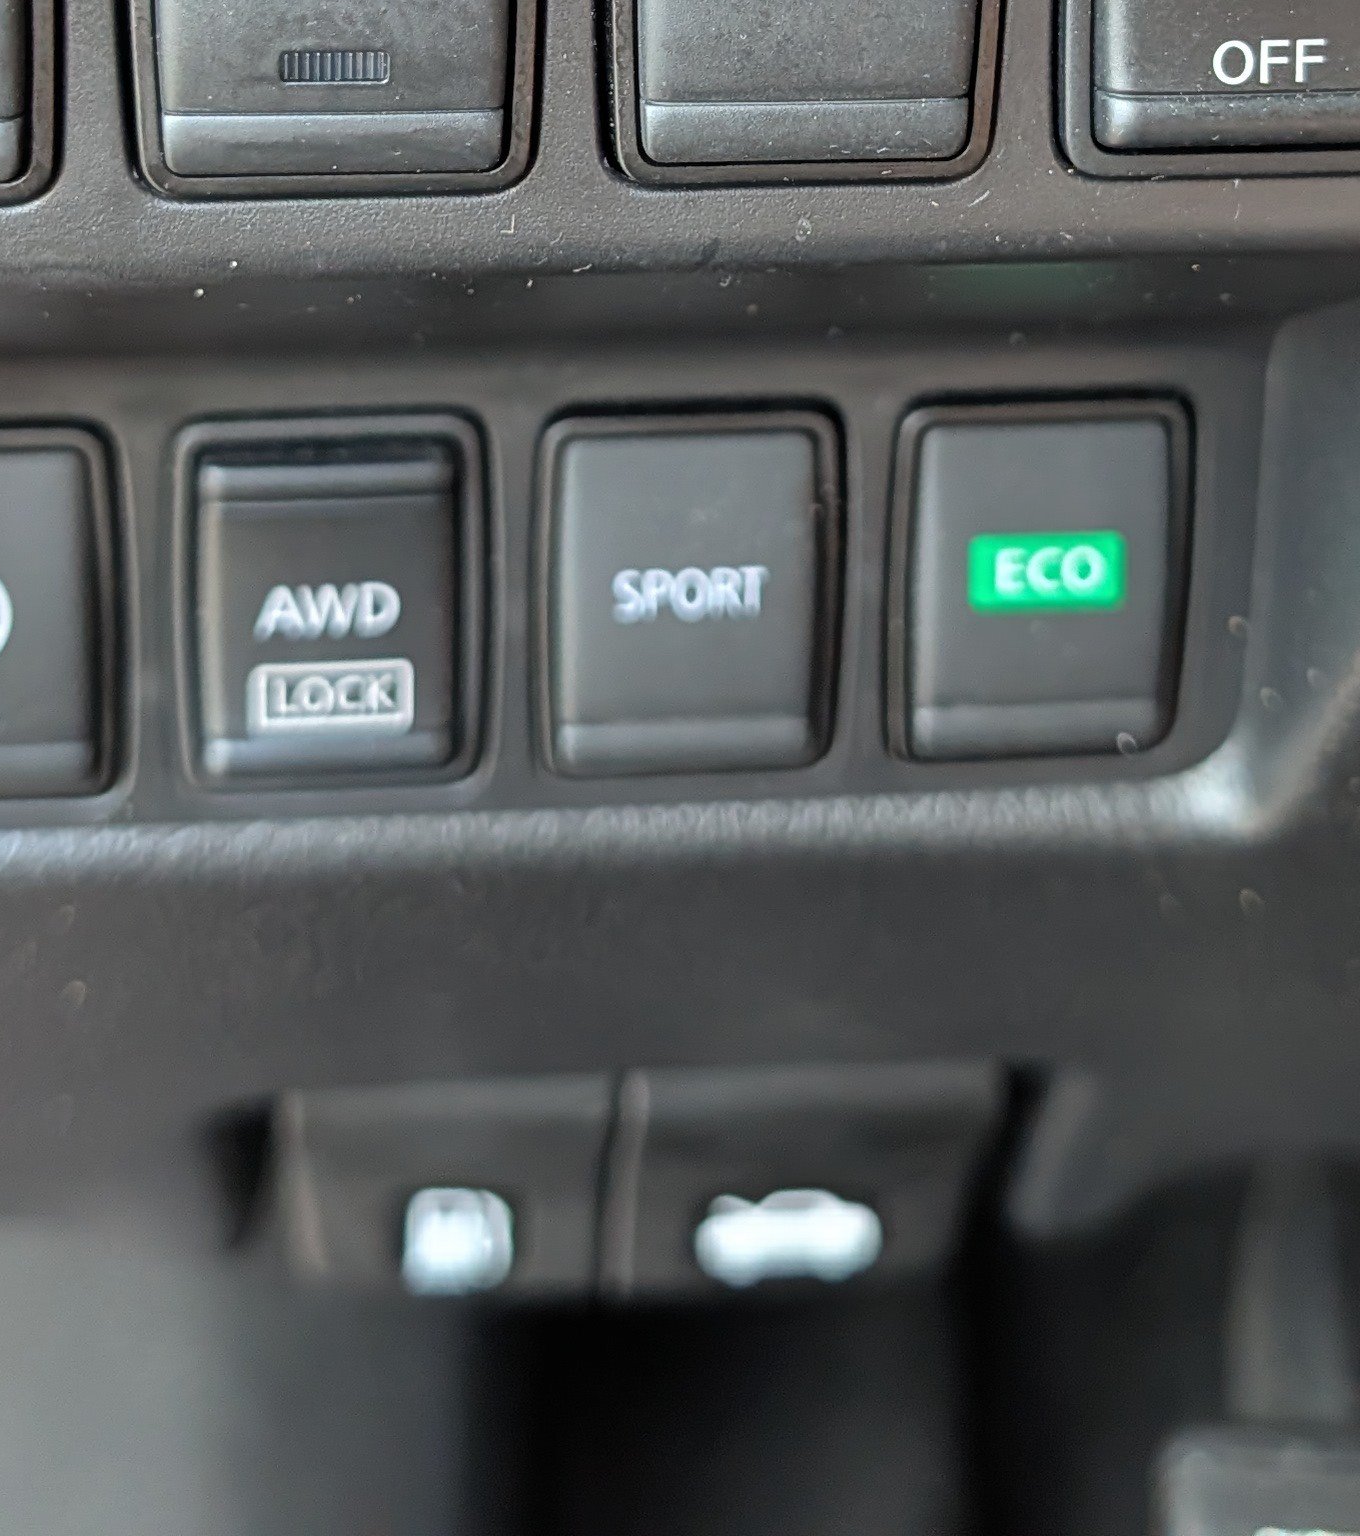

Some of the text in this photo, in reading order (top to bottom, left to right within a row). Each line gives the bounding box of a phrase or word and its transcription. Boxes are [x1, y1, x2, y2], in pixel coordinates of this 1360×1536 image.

[1212, 38, 1326, 86] OFF
[612, 565, 767, 622] SPORT
[993, 544, 1106, 596] ECO
[254, 580, 401, 639] AWD
[273, 673, 397, 715] LOCK
